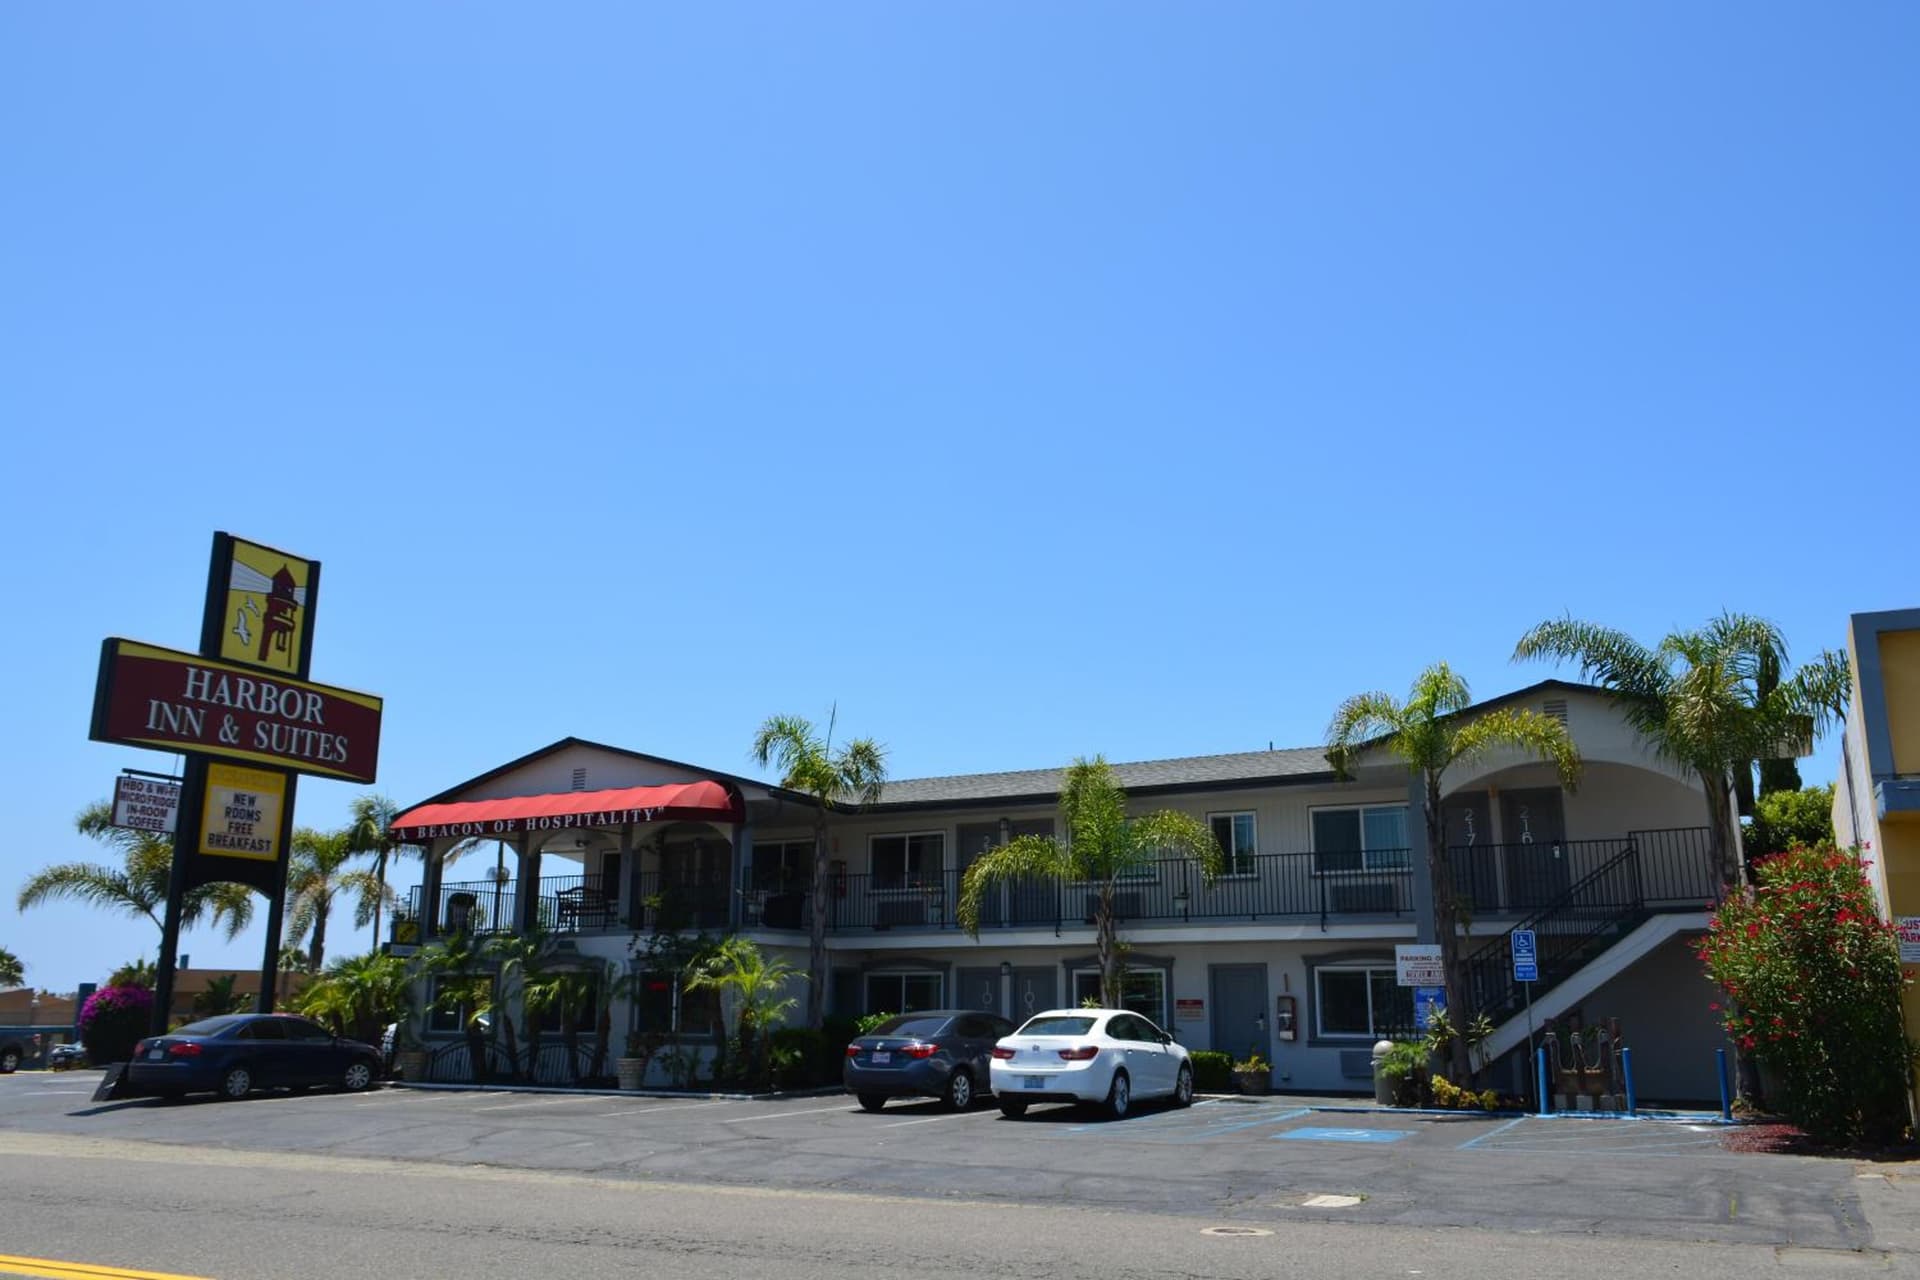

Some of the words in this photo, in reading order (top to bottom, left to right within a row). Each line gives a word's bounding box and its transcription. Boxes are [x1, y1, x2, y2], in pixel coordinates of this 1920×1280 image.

[183, 666, 325, 726] HARBOR
[145, 699, 207, 738] INN
[218, 713, 240, 745] &
[254, 720, 349, 764] SUITES
[233, 792, 257, 807] NEW
[127, 804, 168, 818] IN-ROOM
[224, 806, 262, 822] ROOMS
[127, 815, 165, 831] COFFEE
[228, 820, 255, 836] FREE
[417, 821, 485, 839] BEACON
[493, 819, 516, 833] OF
[207, 832, 273, 853] BREAKFAST
